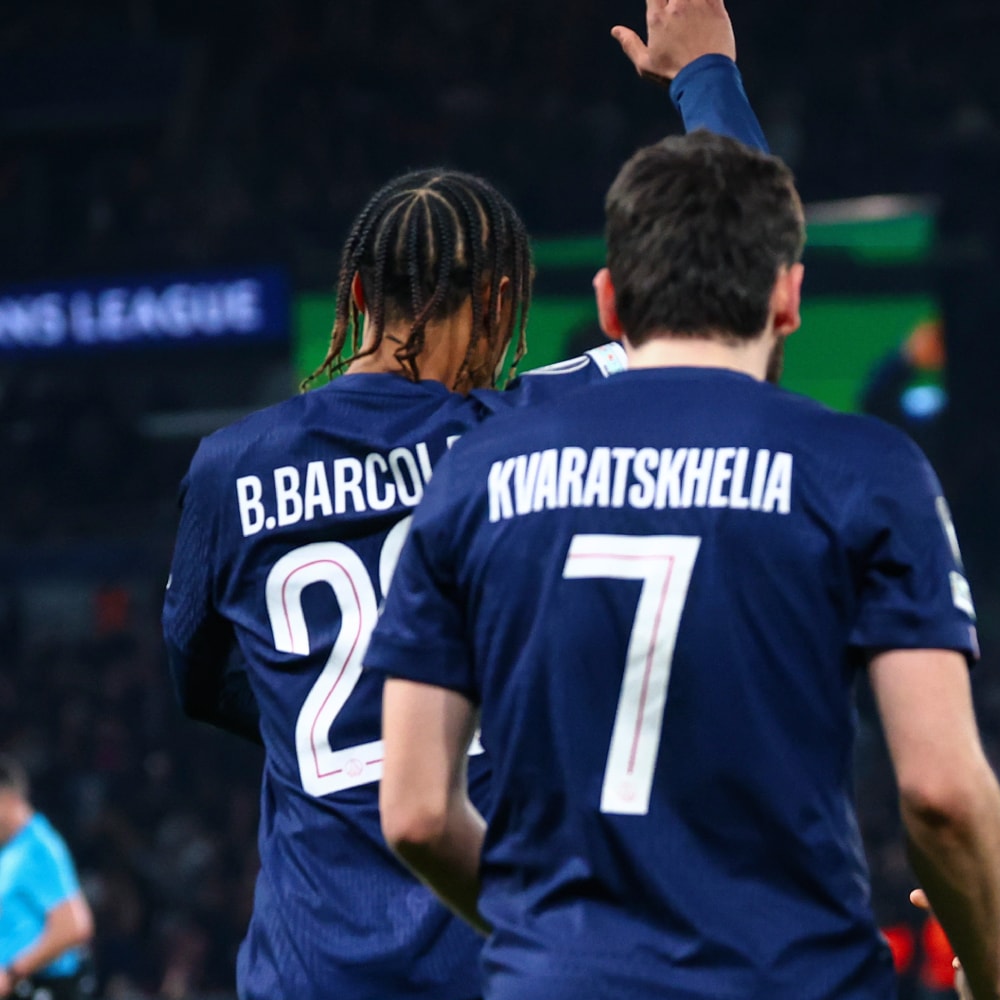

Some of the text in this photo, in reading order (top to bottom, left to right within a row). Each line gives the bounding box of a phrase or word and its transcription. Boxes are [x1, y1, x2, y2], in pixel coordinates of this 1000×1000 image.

[70, 278, 262, 344] LEAGUE
[236, 435, 462, 537] B.BARCO
[487, 446, 793, 523] KVARATSKHELIA
[265, 514, 412, 798] 2
[562, 533, 702, 816] 7
